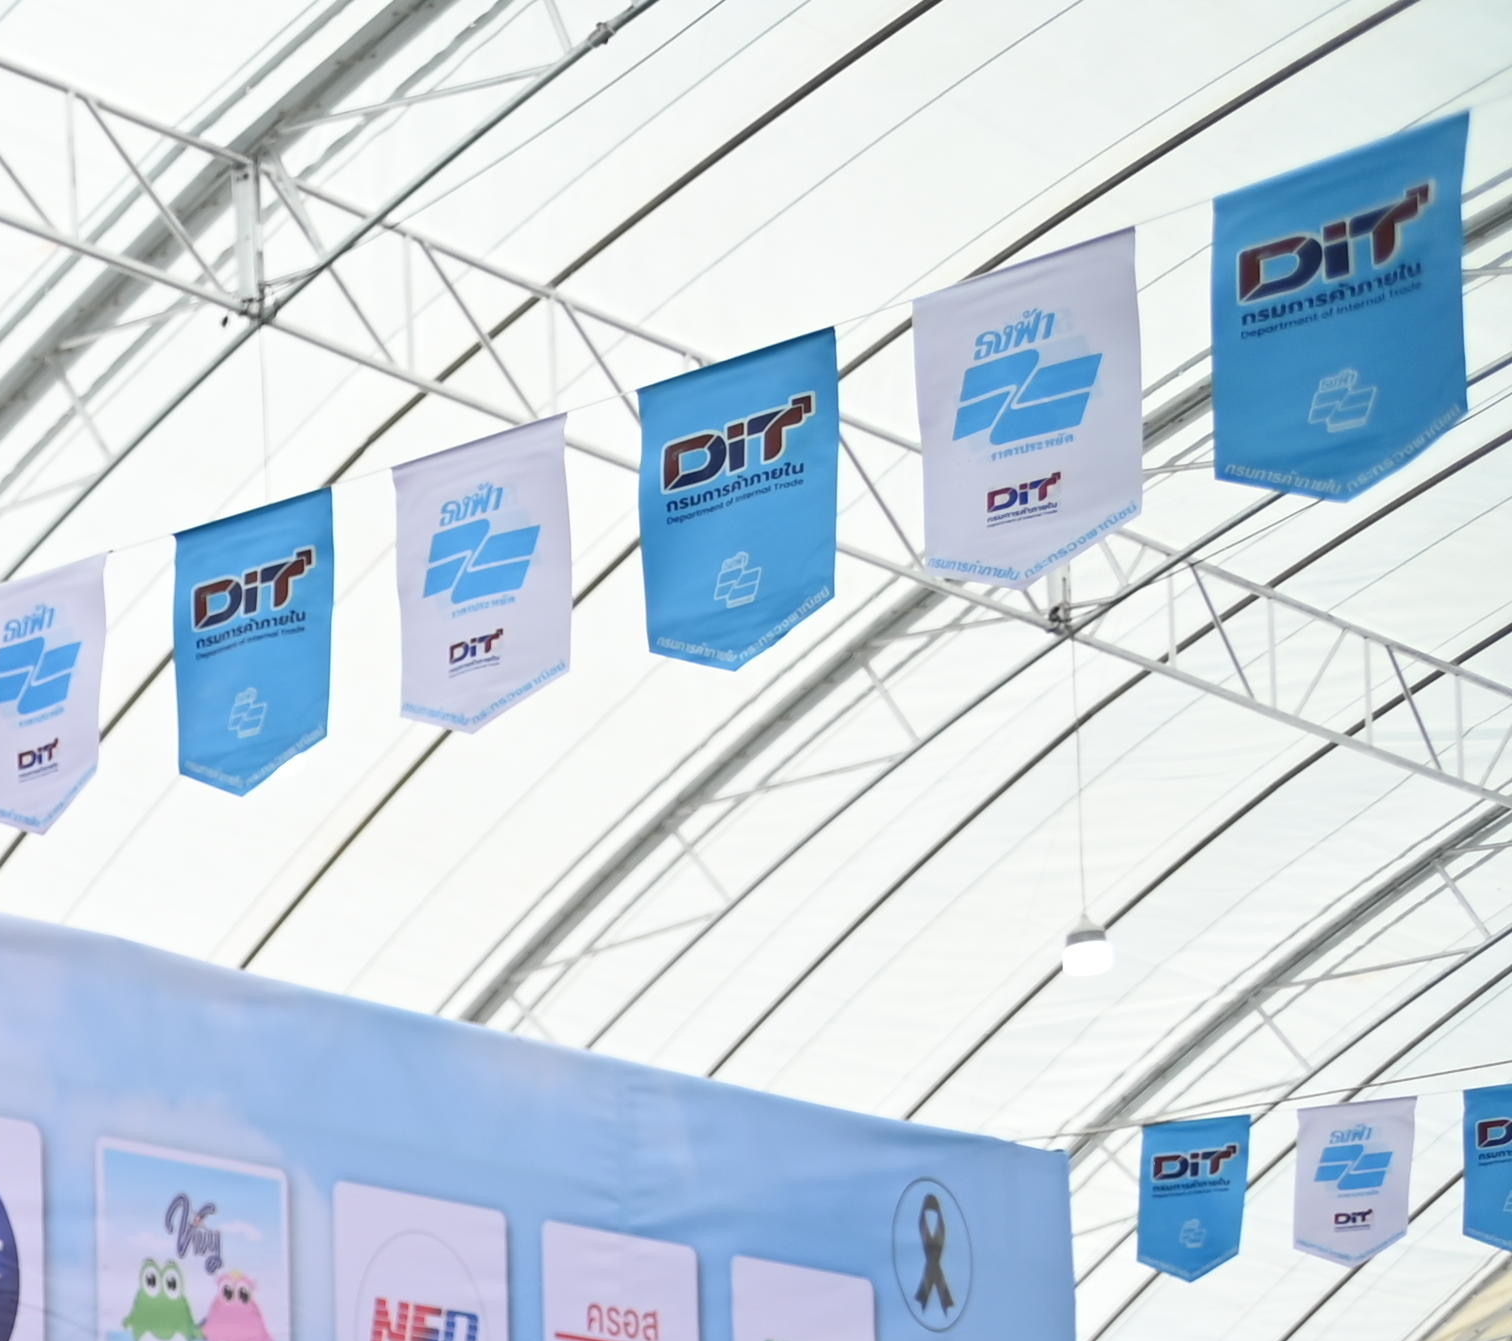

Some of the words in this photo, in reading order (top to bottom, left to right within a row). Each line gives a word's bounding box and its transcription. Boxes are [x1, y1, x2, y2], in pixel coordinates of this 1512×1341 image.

[974, 309, 1057, 361] ธงฟ้า
[439, 482, 504, 527] ธงฟ้า
[666, 460, 805, 514] กรมการค้าภายใน
[3, 603, 56, 643] ธงฟ้า
